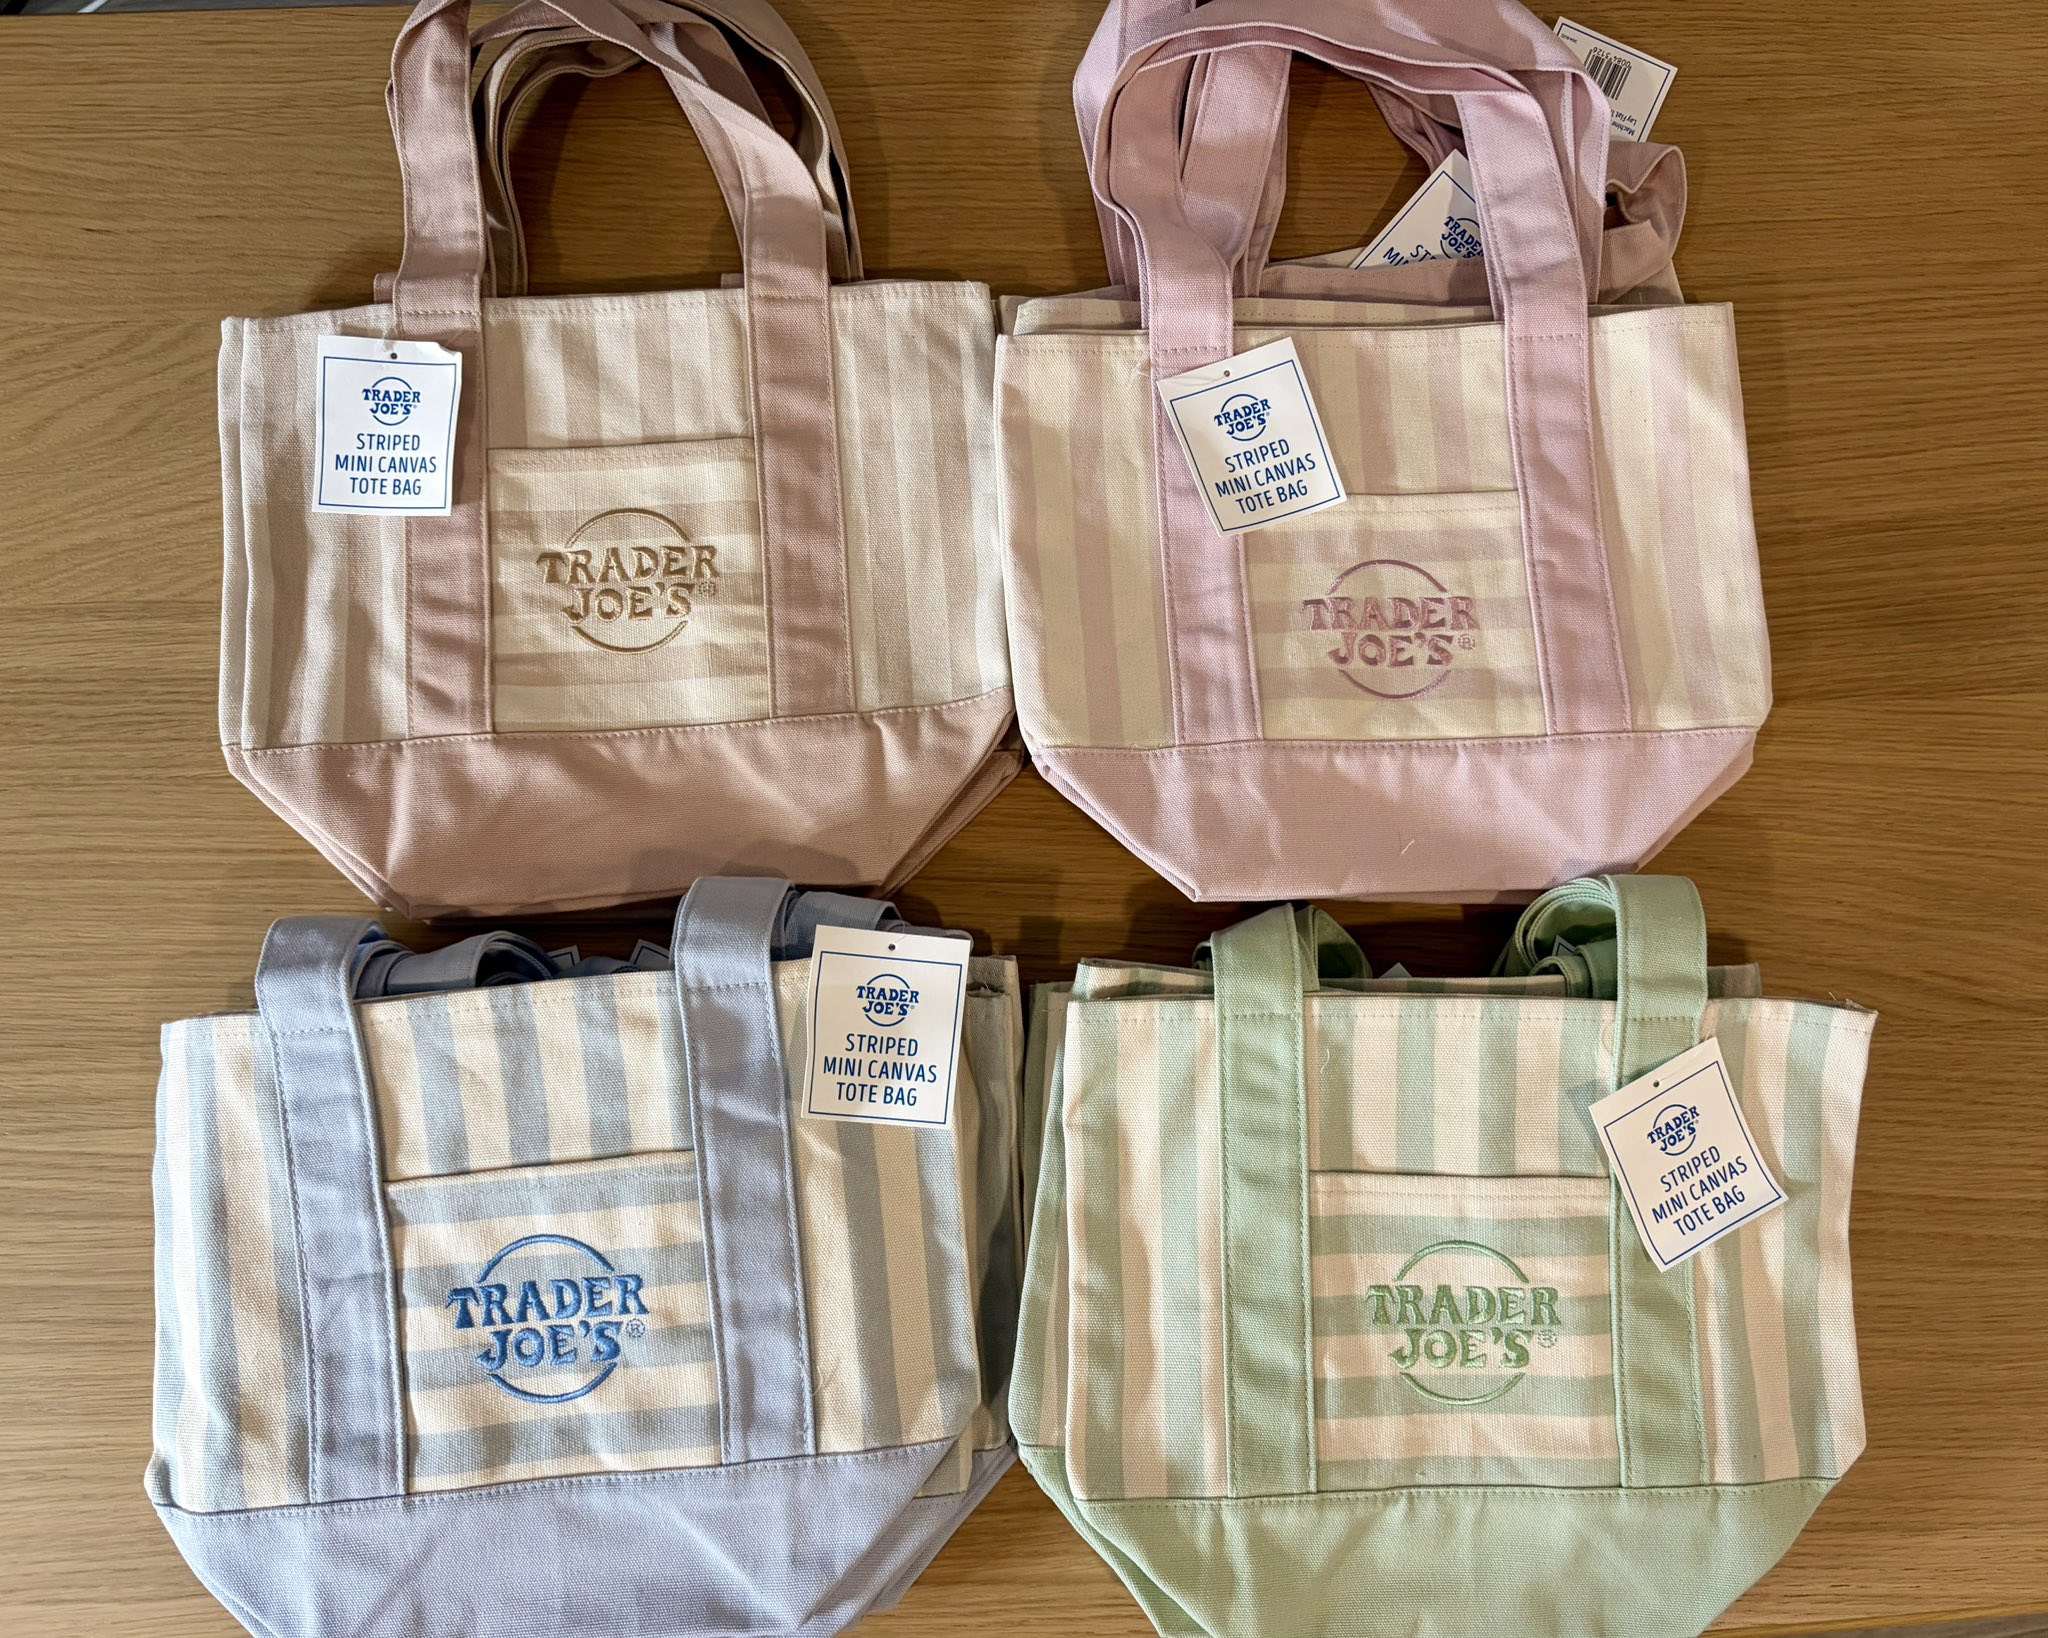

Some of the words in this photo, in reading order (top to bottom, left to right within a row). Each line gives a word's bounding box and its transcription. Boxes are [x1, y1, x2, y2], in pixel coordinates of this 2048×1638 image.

[1593, 46, 1611, 60] 3126
[362, 388, 421, 404] TRADER
[1213, 398, 1272, 427] TRADER
[356, 432, 421, 451] STRIPED
[1224, 438, 1290, 473] STRIPED
[335, 454, 373, 472] MINI
[378, 456, 437, 473] CANVAS
[1215, 474, 1252, 498] MINI
[1254, 452, 1317, 487] CANVAS
[350, 477, 388, 495] TOTE
[392, 478, 422, 496] BAG
[1235, 490, 1275, 514] TOTE
[1276, 479, 1309, 503] BAG
[536, 545, 720, 584] TRADER
[1300, 596, 1480, 631] TRADER
[856, 985, 920, 1004] TRADER
[845, 1033, 919, 1057] STRIPED
[823, 1055, 863, 1077] MINI
[868, 1059, 938, 1083] CANVAS
[836, 1081, 878, 1103] TOTE
[883, 1085, 918, 1107] BAG
[1647, 1105, 1700, 1145] TRADER
[1660, 1145, 1721, 1193] STRIPED
[1651, 1191, 1689, 1224] MINI
[1689, 1155, 1748, 1201] CANVAS
[1673, 1203, 1714, 1236] TOTE
[1713, 1185, 1746, 1215] BAG
[445, 1274, 650, 1329] TRADER
[1365, 1284, 1562, 1326] TRADER
